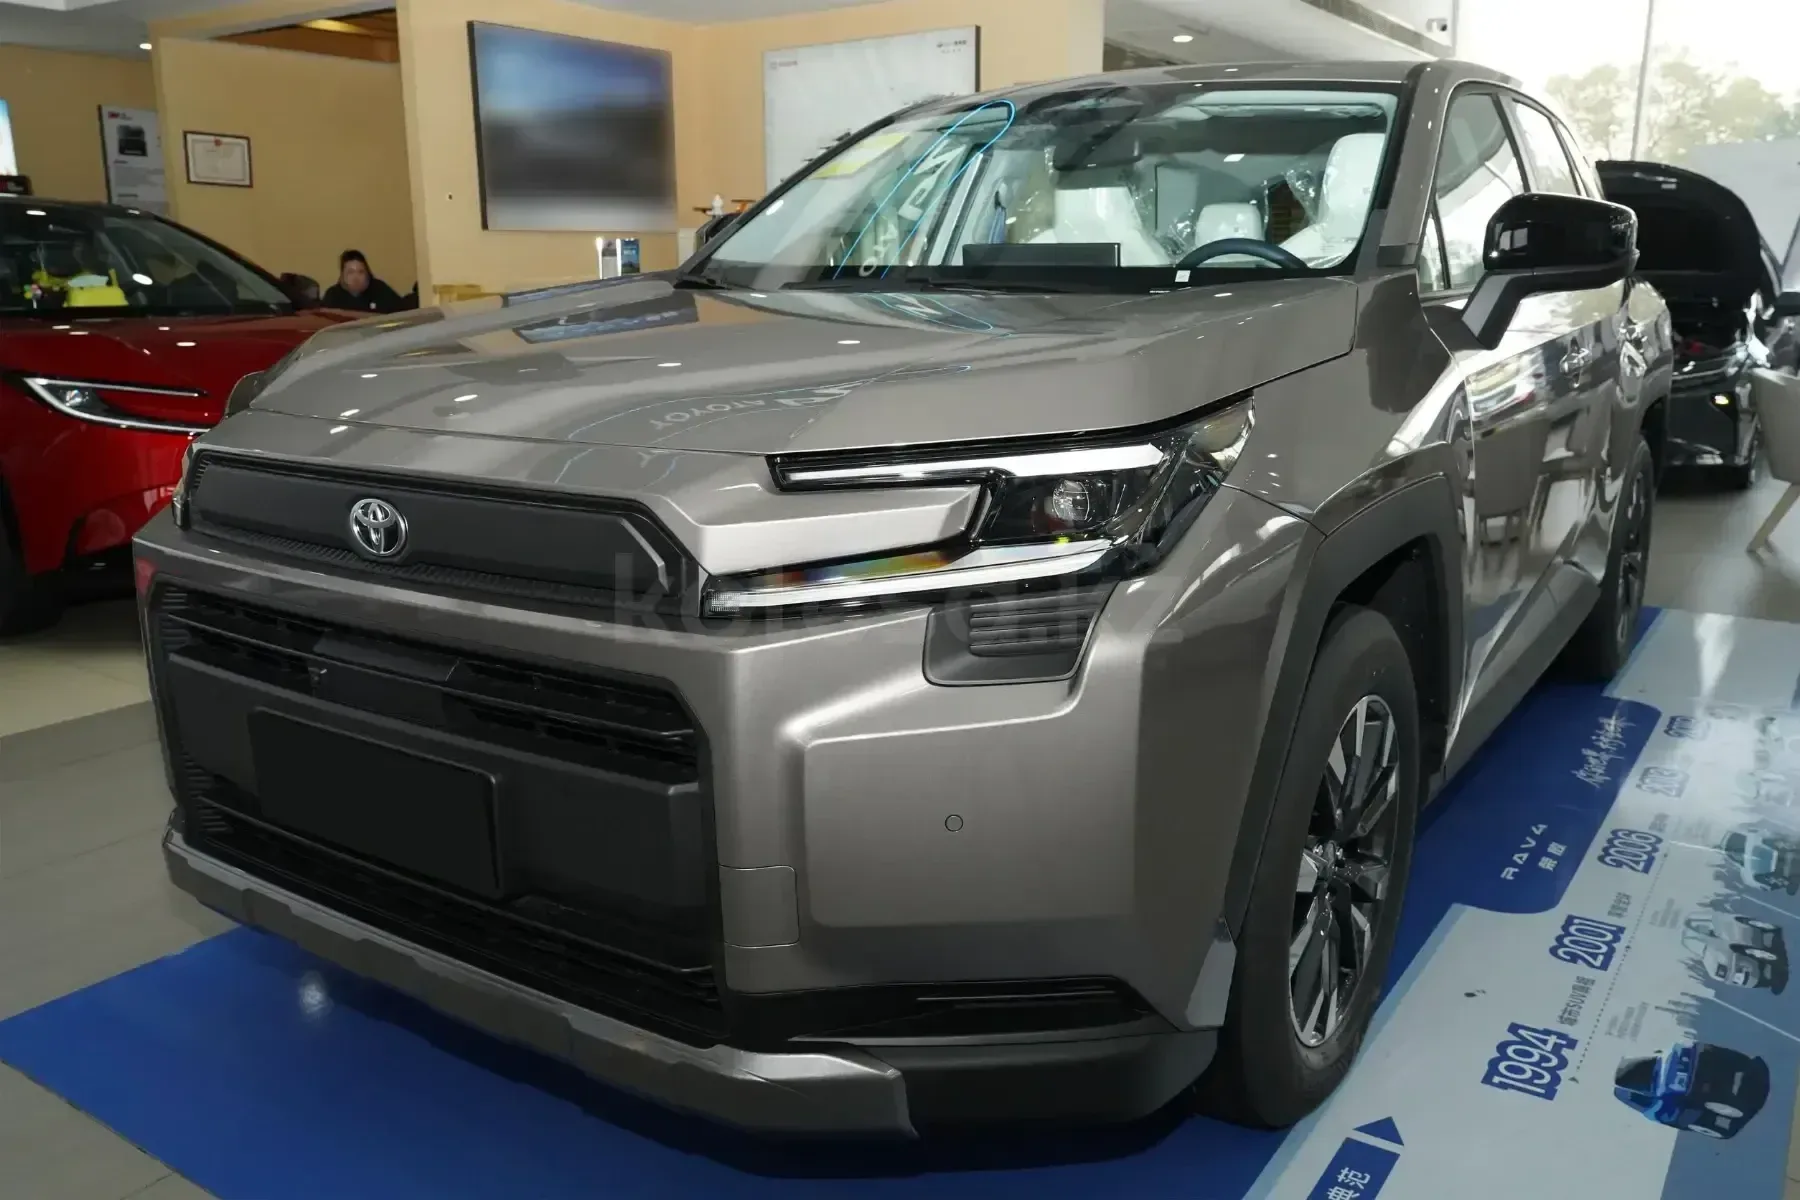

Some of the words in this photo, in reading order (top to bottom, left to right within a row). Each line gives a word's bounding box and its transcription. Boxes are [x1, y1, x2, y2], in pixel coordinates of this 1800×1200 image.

[1501, 824, 1548, 880] RAV4
[1601, 830, 1659, 873] 2006
[1554, 917, 1619, 968] 2001
[1488, 1027, 1570, 1096] 1994
